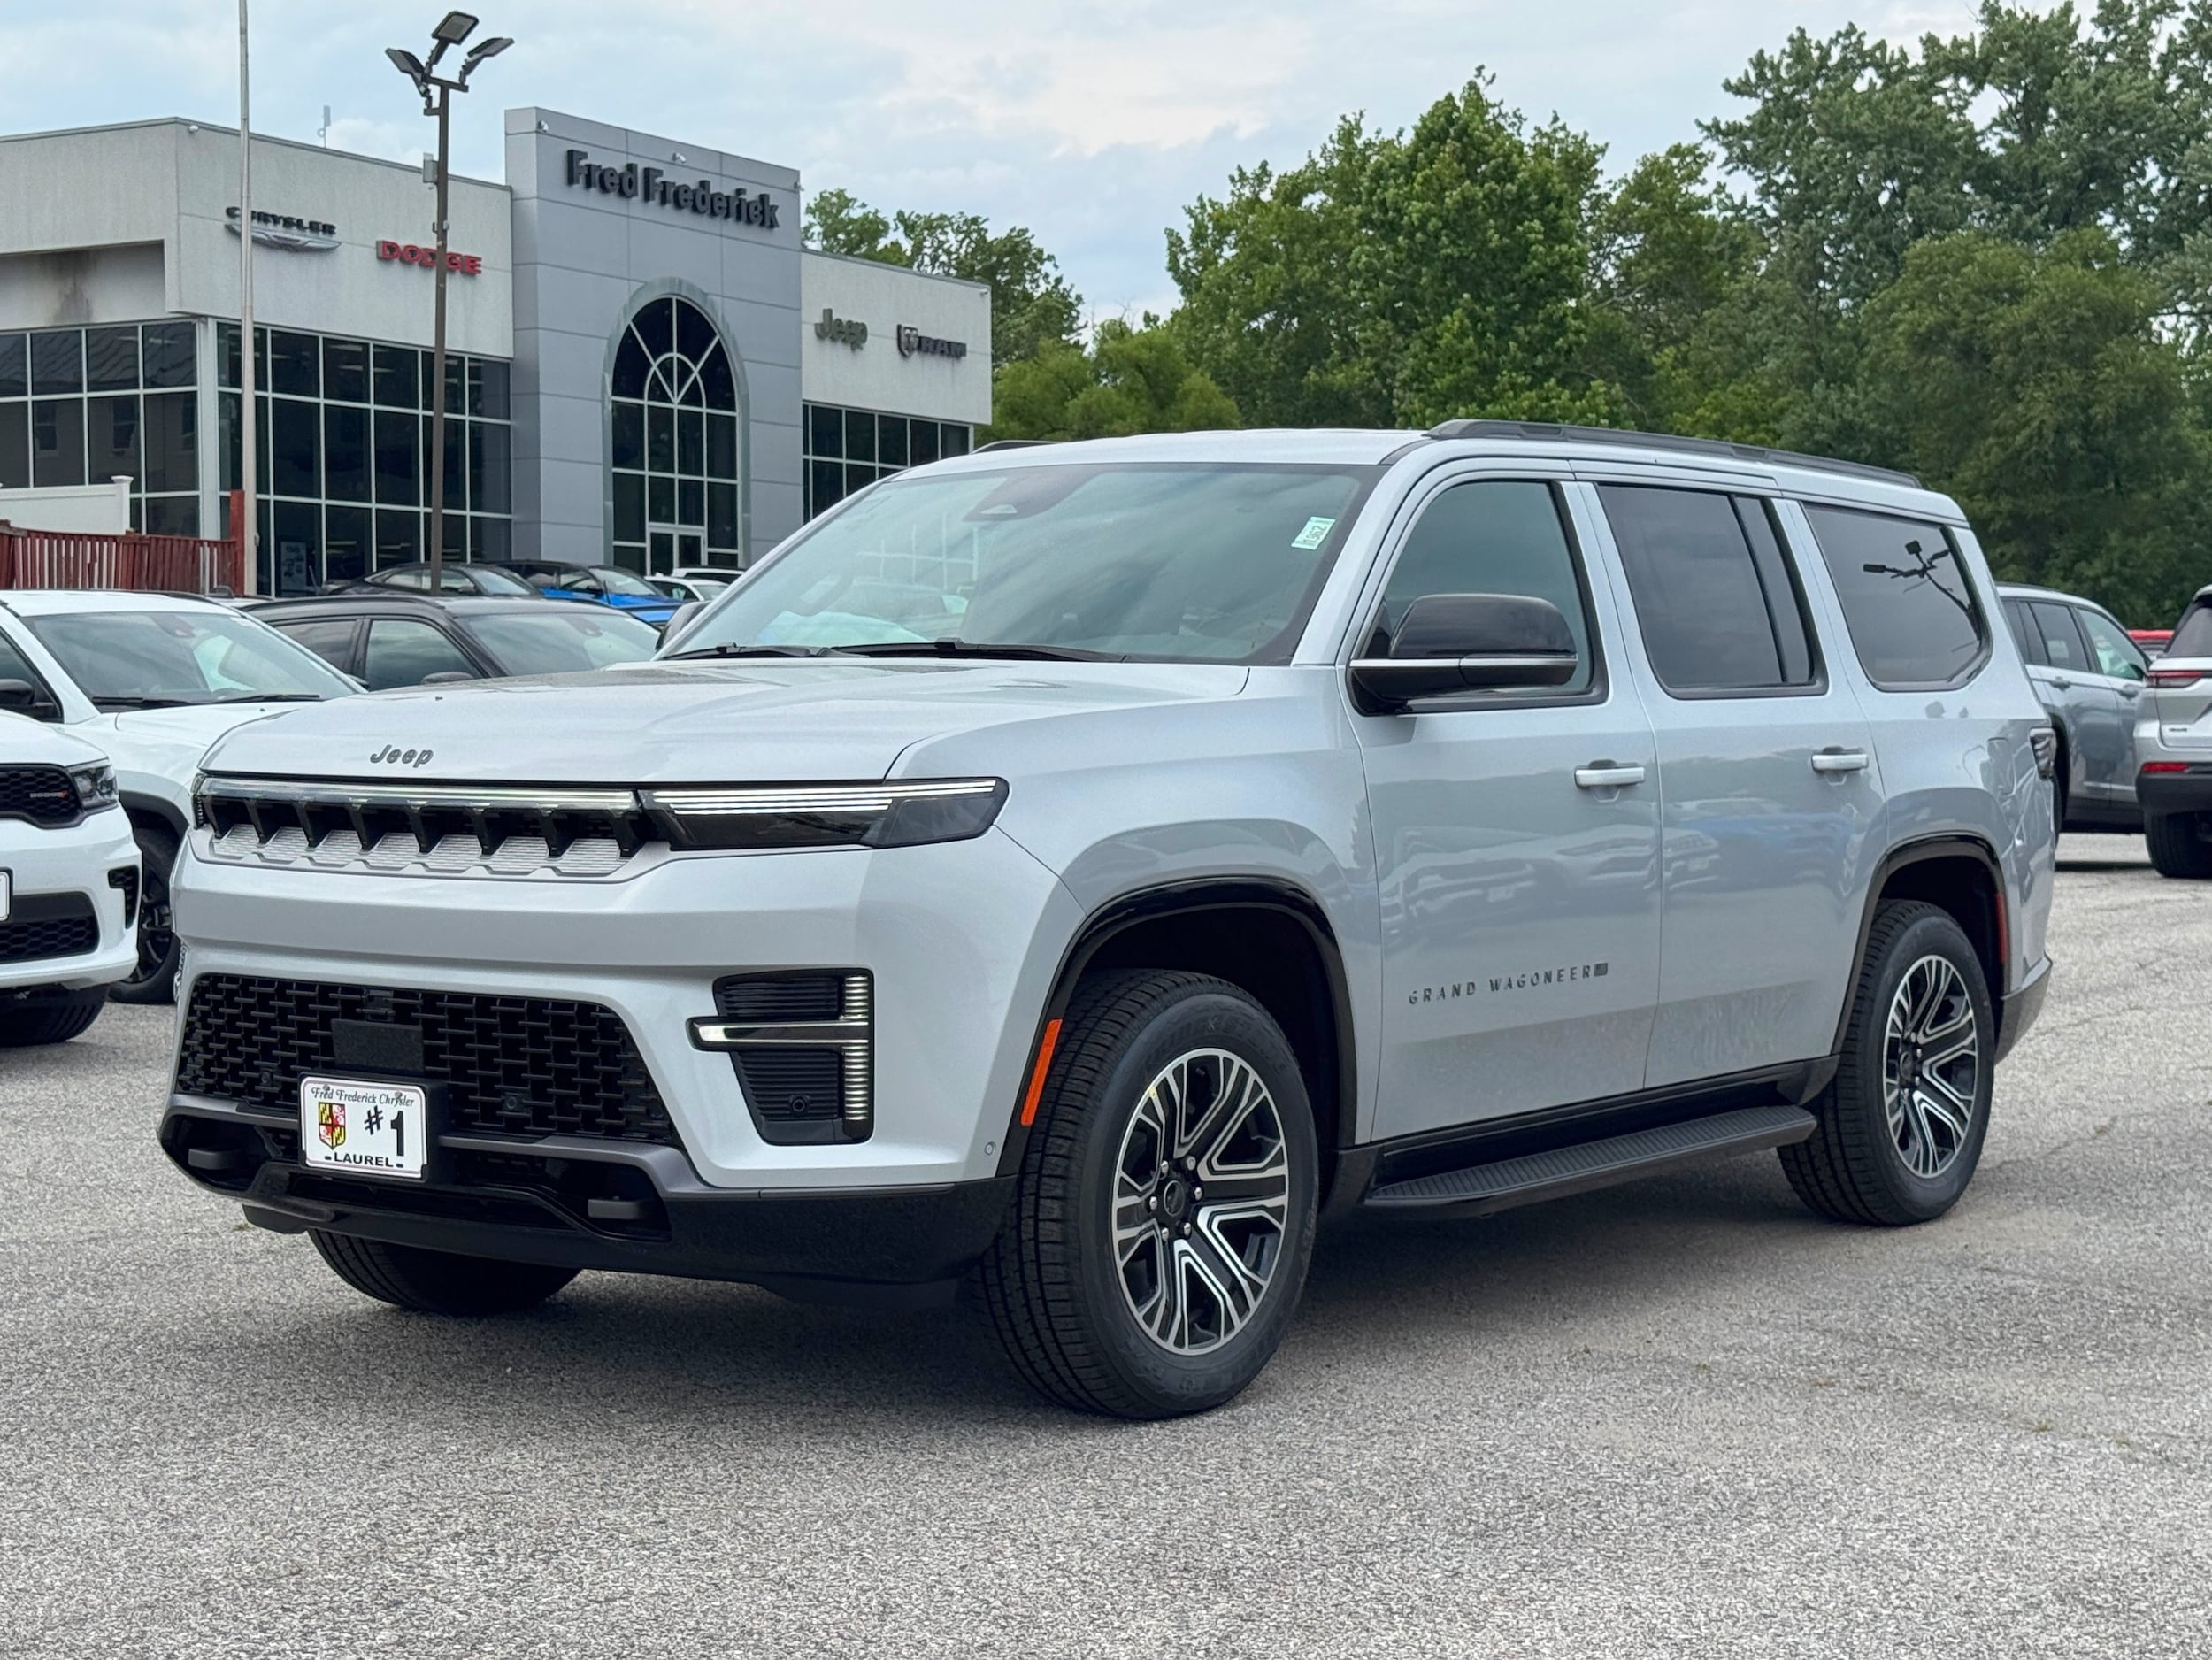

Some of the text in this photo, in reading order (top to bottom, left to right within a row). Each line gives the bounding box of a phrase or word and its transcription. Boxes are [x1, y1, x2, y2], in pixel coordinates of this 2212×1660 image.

[566, 149, 779, 229] Fred Frederick
[376, 240, 482, 275] DODGE
[814, 308, 868, 350] Jeep
[370, 744, 434, 768] Jeep
[1409, 965, 1591, 1005] GRAND WAGONEER
[311, 1087, 415, 1108] Fred Frederick Chrysler
[334, 1151, 394, 1168] LAUREL
